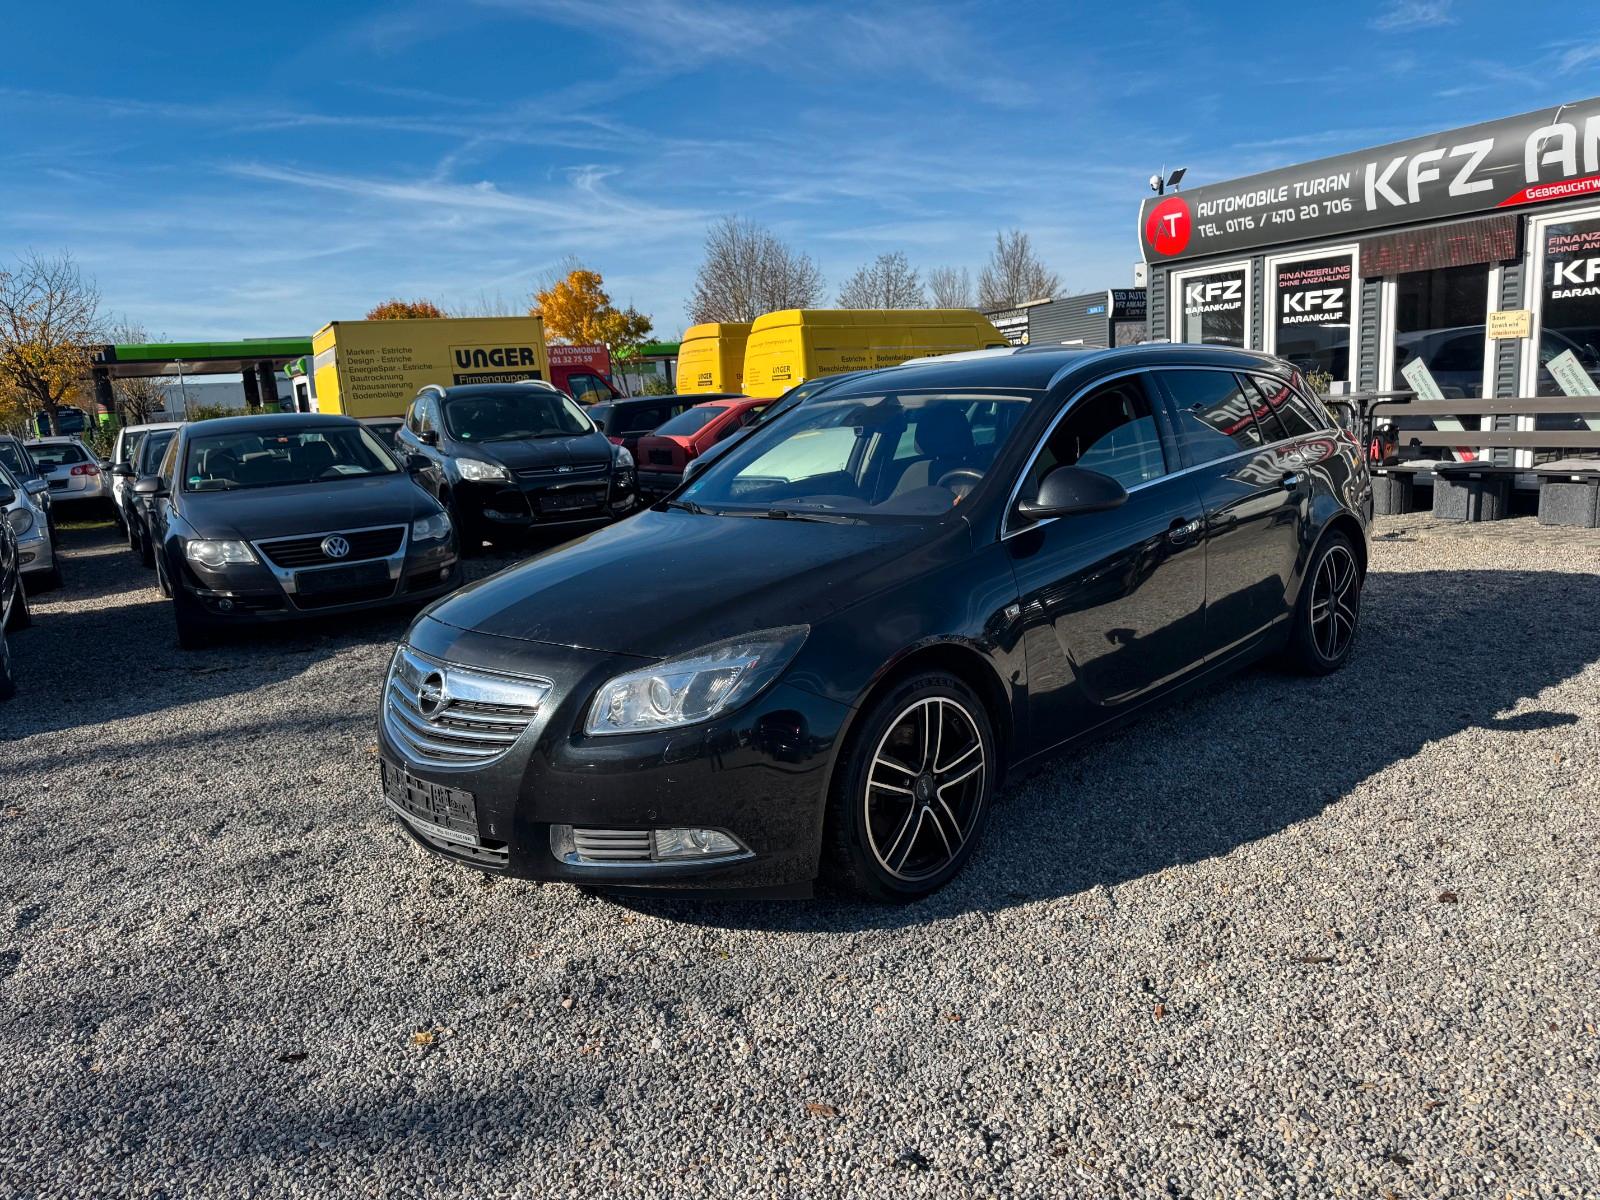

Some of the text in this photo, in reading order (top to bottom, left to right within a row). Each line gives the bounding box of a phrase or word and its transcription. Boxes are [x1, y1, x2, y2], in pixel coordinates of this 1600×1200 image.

[1364, 138, 1495, 212] KFZ
[1197, 172, 1351, 218] AUTOMOBILE TURAN
[1198, 198, 1352, 238] TEL. 0176 / 470 20 706
[1548, 244, 1580, 254] OHNE
[1279, 264, 1351, 280] FINANZIERUNG
[1279, 273, 1350, 288] OHNE ANZAHLUNG
[1186, 279, 1242, 305] KFZ
[1283, 287, 1344, 314] KFZ
[1185, 302, 1242, 314] BARANKAUF
[1282, 312, 1343, 324] BARANKAUF
[346, 348, 375, 356] Marken
[382, 347, 412, 355] Estriche
[553, 347, 601, 355] AUTOMOBILE
[347, 357, 374, 365] Design
[381, 355, 412, 363] Estriche
[455, 347, 535, 369] UNGER
[348, 366, 396, 374] EnergieSpar
[403, 363, 433, 371] Estriche
[350, 374, 404, 383] Bautrocknung
[459, 373, 530, 385] Firmengruppe
[351, 381, 414, 391] Altbausanierung
[352, 390, 404, 400] Bodenbeläge
